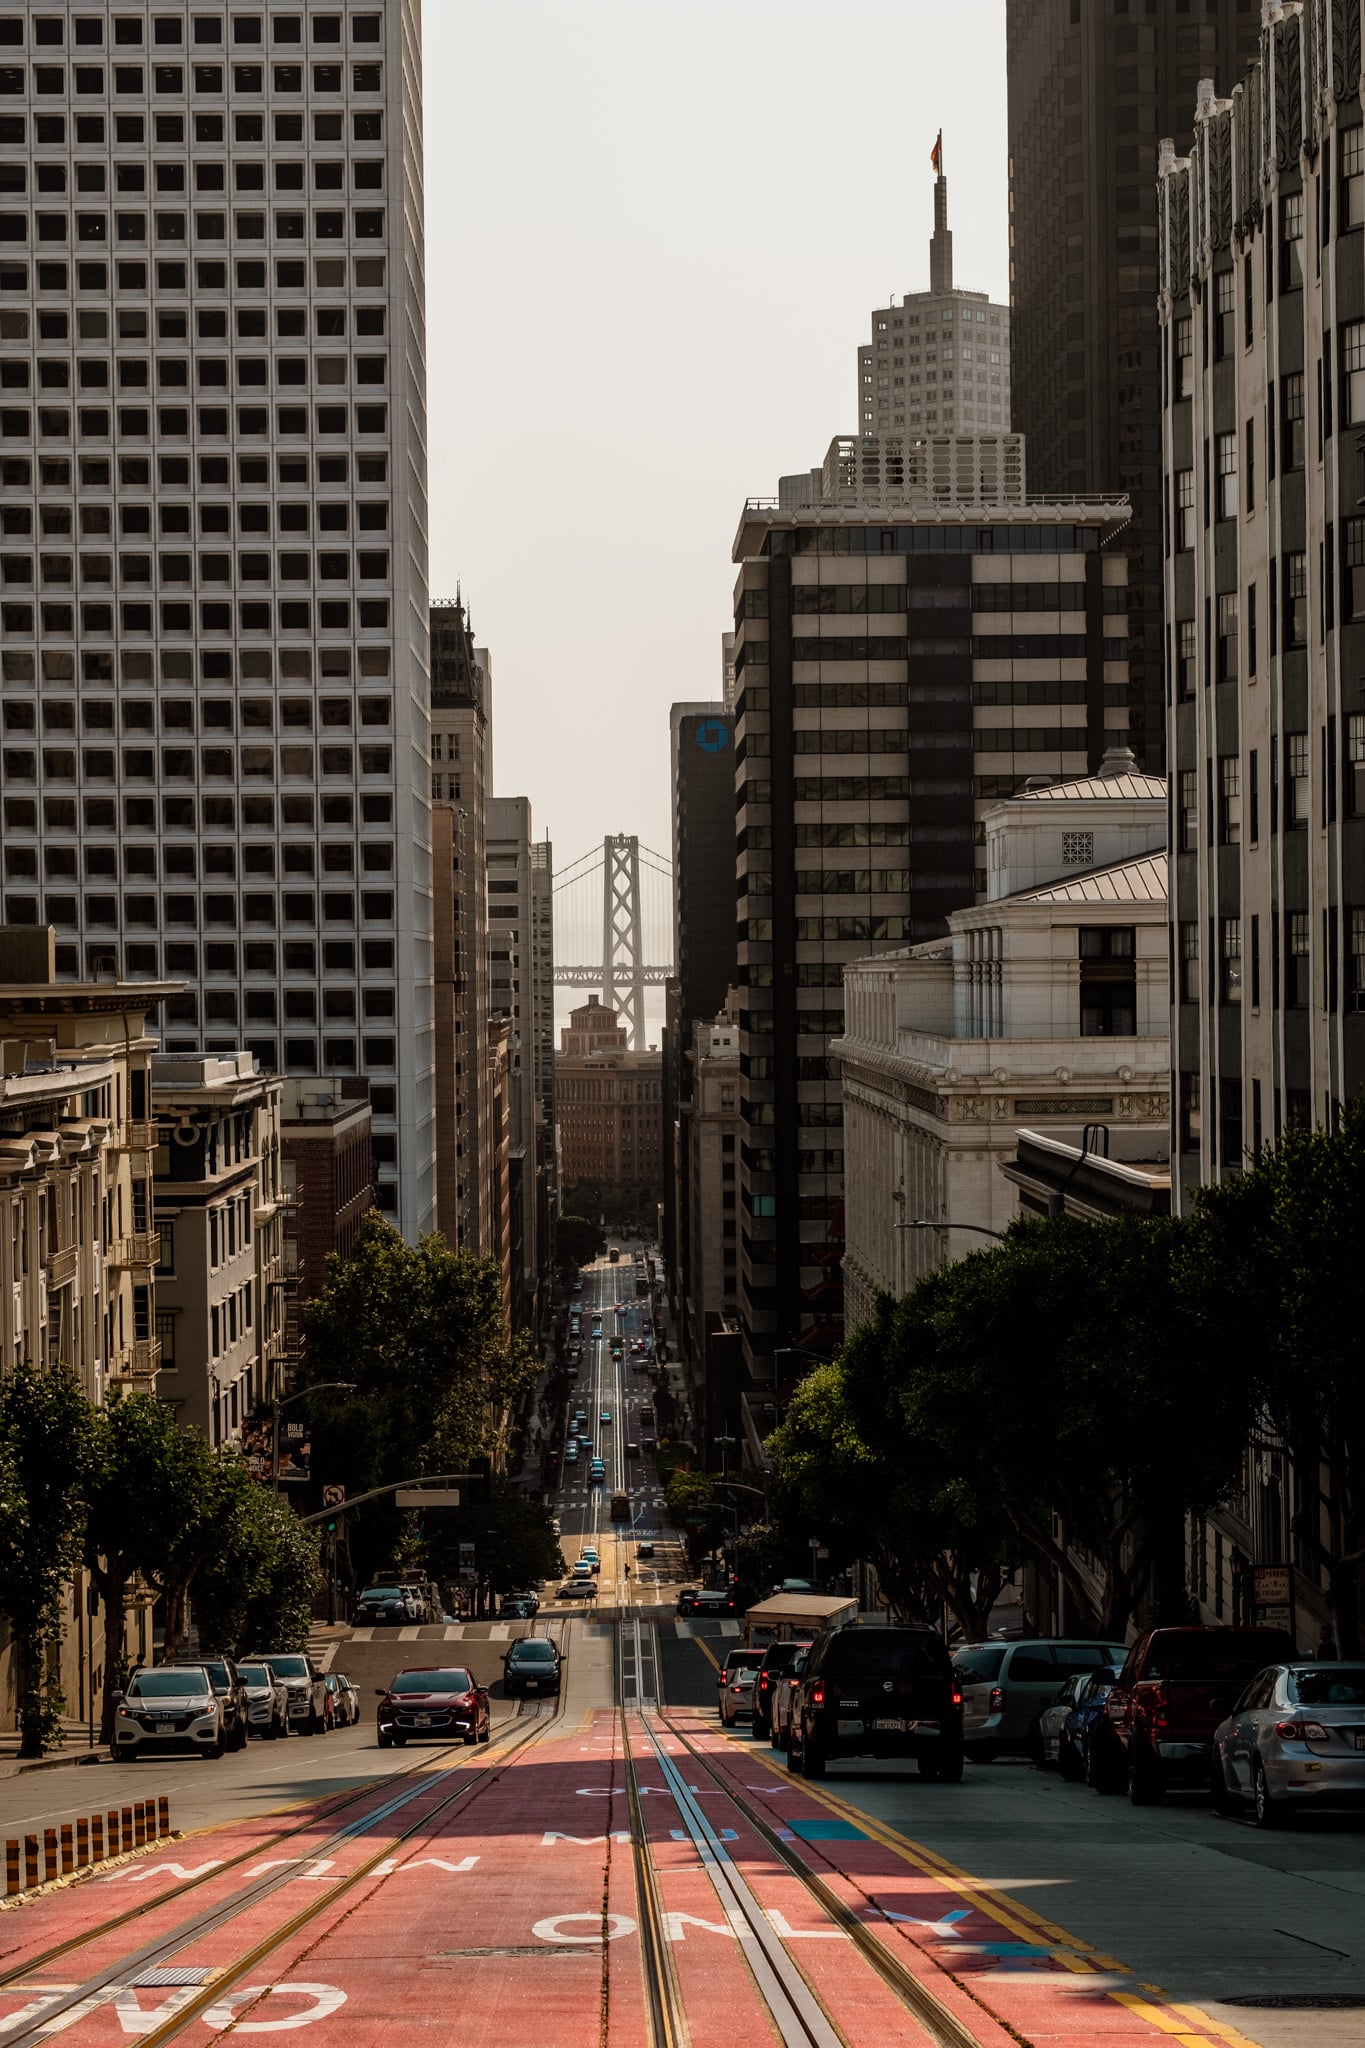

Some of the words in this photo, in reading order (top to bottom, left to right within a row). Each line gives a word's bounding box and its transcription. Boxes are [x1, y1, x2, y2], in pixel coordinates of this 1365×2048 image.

[288, 1423, 303, 1431] BOLD
[1257, 1609, 1264, 1619] 2
[575, 1785, 793, 1797] ONLY
[531, 1908, 973, 1944] ONLY
